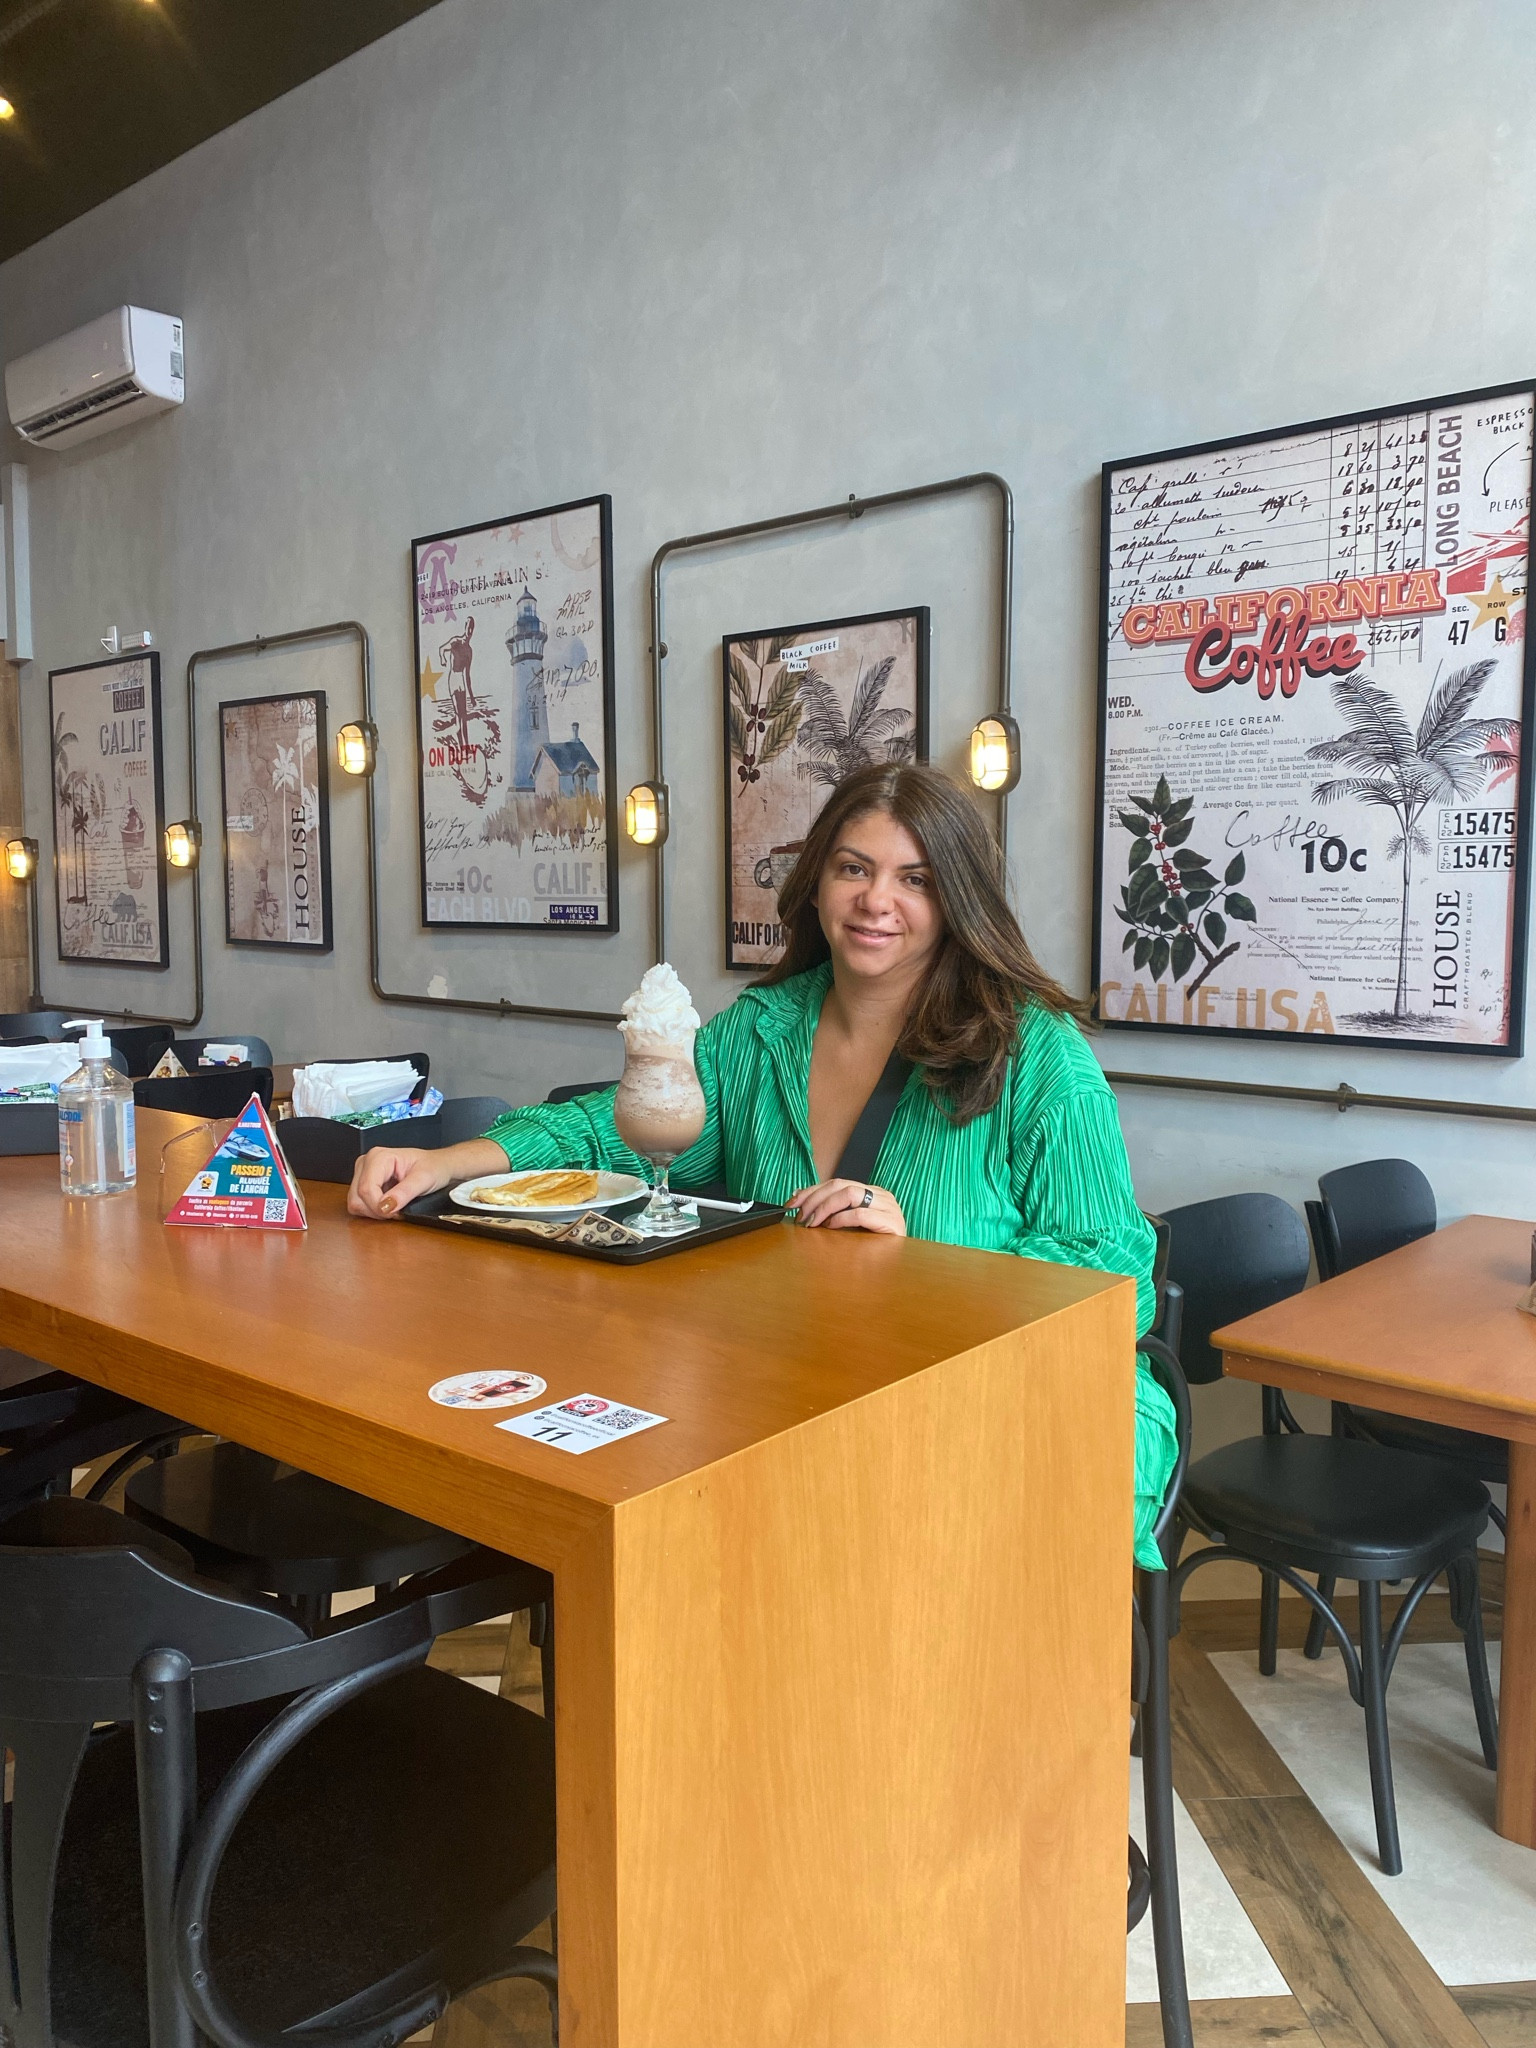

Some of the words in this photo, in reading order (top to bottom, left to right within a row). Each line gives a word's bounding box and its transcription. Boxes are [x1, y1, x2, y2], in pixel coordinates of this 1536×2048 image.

[1477, 408, 1533, 427] ESPRESSO
[1493, 422, 1524, 434] BLACK
[1437, 414, 1462, 496] BEACH
[1489, 496, 1531, 513] PLEASE
[1435, 502, 1460, 568] LONG
[472, 594, 511, 606] CALIFORNIA
[1123, 571, 1447, 646] CALIFORNIA
[1448, 620, 1469, 645] 47
[1495, 617, 1506, 641] G
[781, 650, 803, 660] BLACK
[810, 641, 836, 653] COFFEE
[1184, 610, 1367, 699] Coffee
[1108, 696, 1134, 708] WED.
[1108, 711, 1124, 719] 8.00
[1127, 709, 1143, 717] P.M.
[1168, 721, 1211, 730] COFFEE
[1215, 718, 1235, 727] ICE
[1239, 714, 1284, 725] CREAM.
[100, 718, 146, 756] CALIF
[1220, 729, 1238, 738] Café
[429, 747, 444, 767] ON
[448, 745, 477, 766] DUTY
[124, 760, 147, 778] COFFEE
[1203, 801, 1233, 810] Average
[1225, 810, 1343, 851] Coffee
[1454, 812, 1516, 835] 15475
[1301, 837, 1368, 874] 10c
[1453, 845, 1516, 868] 15475
[292, 805, 310, 930] HOUSE
[457, 866, 493, 894] 10c
[482, 896, 531, 923] BLVD
[1365, 896, 1404, 904] Company,
[551, 906, 563, 914] LOS
[566, 907, 595, 915] ANGELES
[1433, 890, 1461, 1009] HOUSE
[1236, 987, 1335, 1036] USA
[231, 1165, 264, 1176] PASSEIO
[266, 1166, 272, 1176] E
[230, 1184, 239, 1193] DE
[240, 1185, 269, 1194] LANCHA
[239, 1177, 270, 1185] ALUGUEL
[532, 1426, 572, 1442] 11
